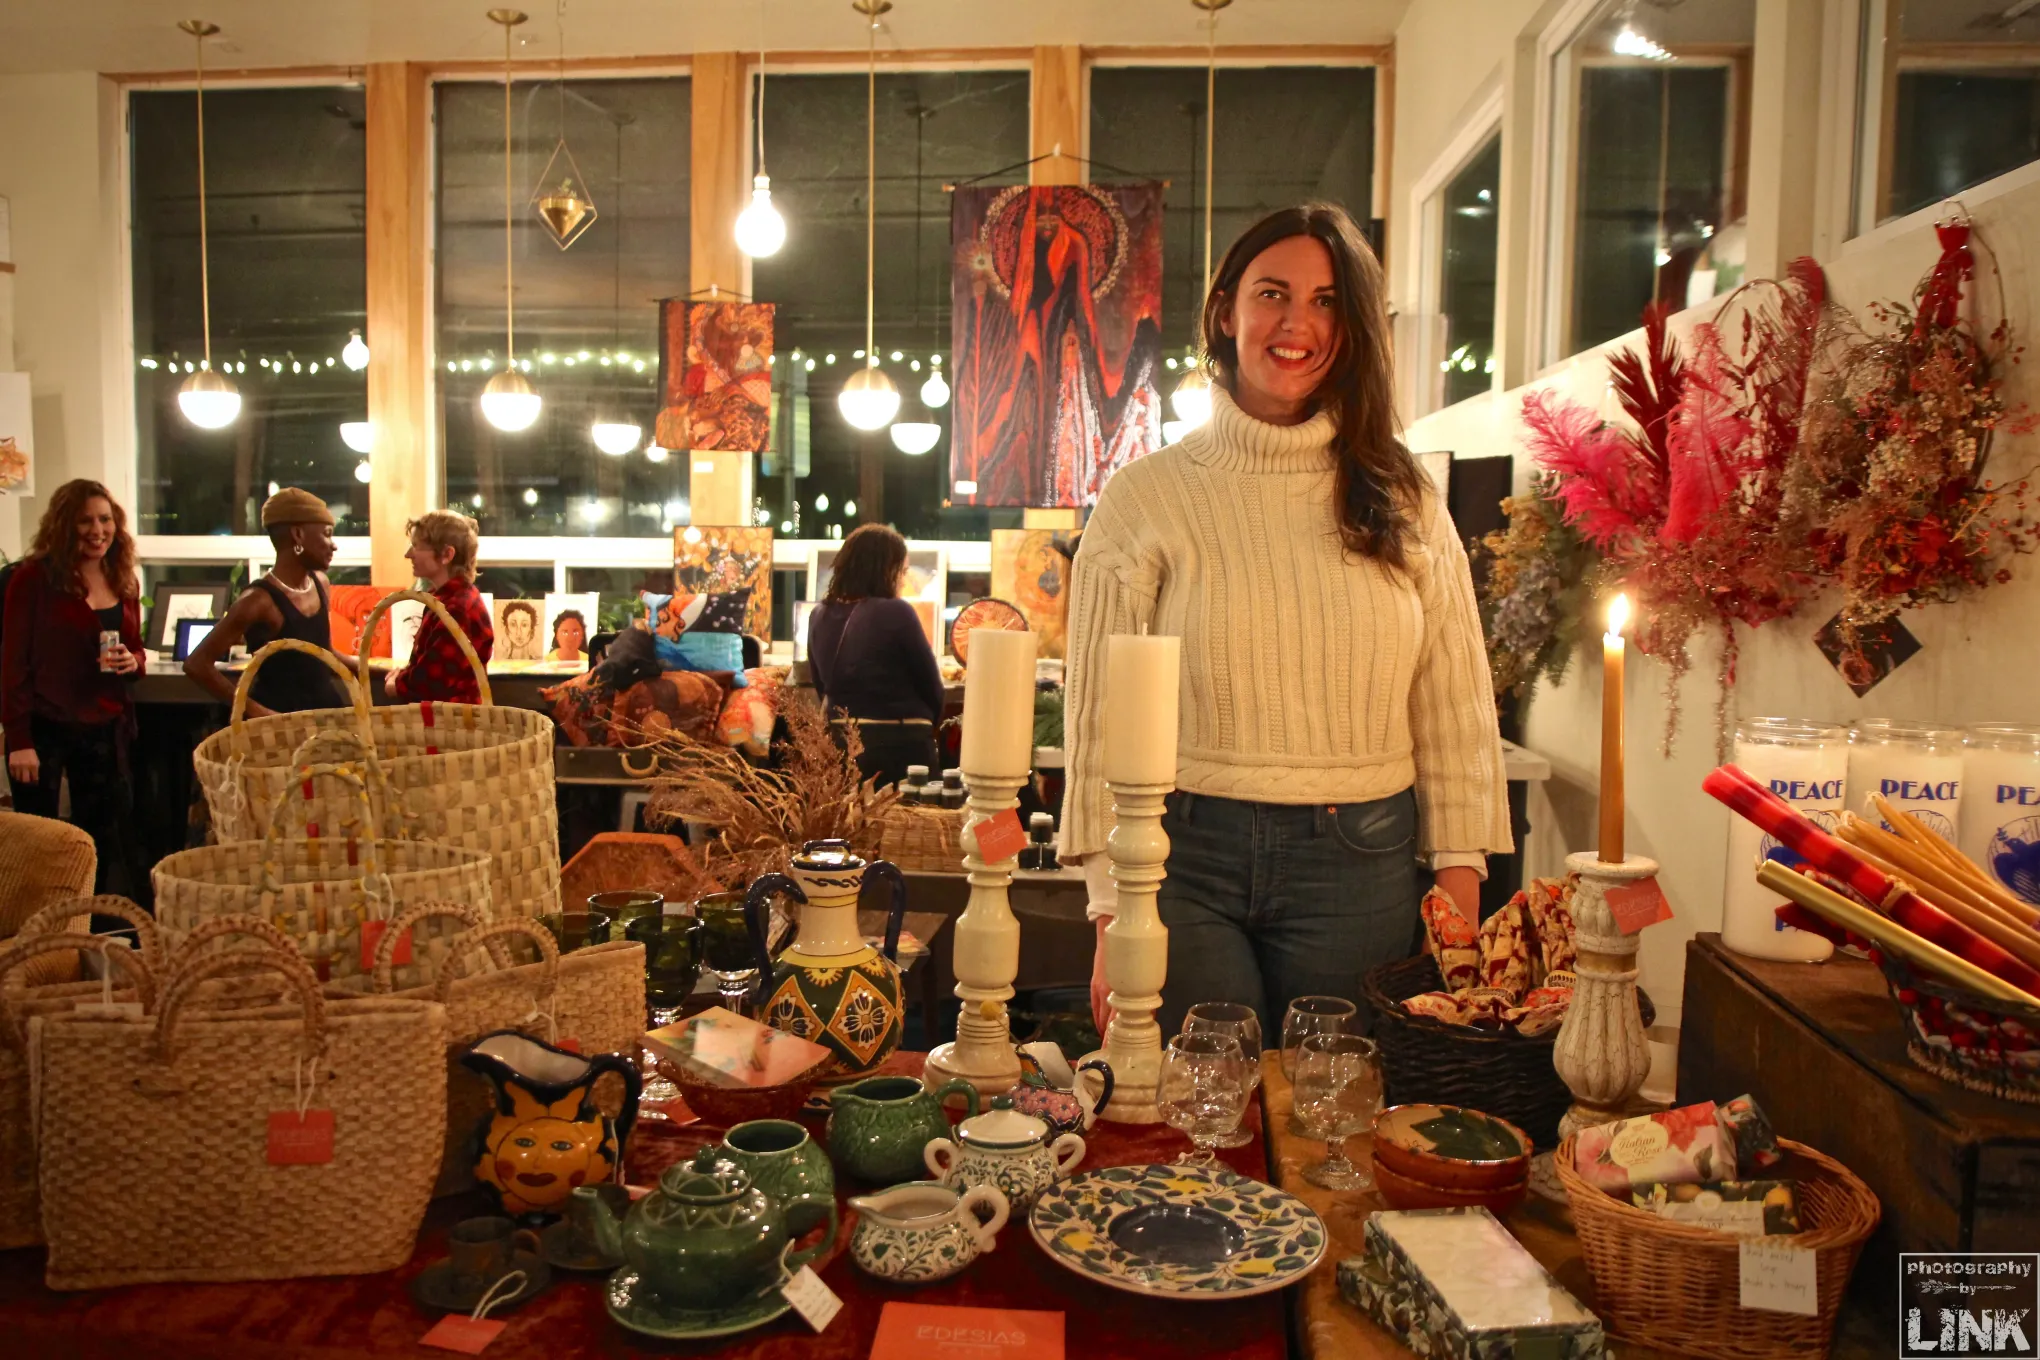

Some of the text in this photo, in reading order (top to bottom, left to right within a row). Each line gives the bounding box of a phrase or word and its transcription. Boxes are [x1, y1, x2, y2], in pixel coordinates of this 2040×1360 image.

[1769, 779, 1844, 800] PEACE
[1880, 778, 1959, 801] PEACE
[1996, 784, 2040, 806] PE
[1619, 1136, 1656, 1151] Italian
[1633, 1145, 1662, 1157] Rose
[917, 1325, 1026, 1346] EDESIAS
